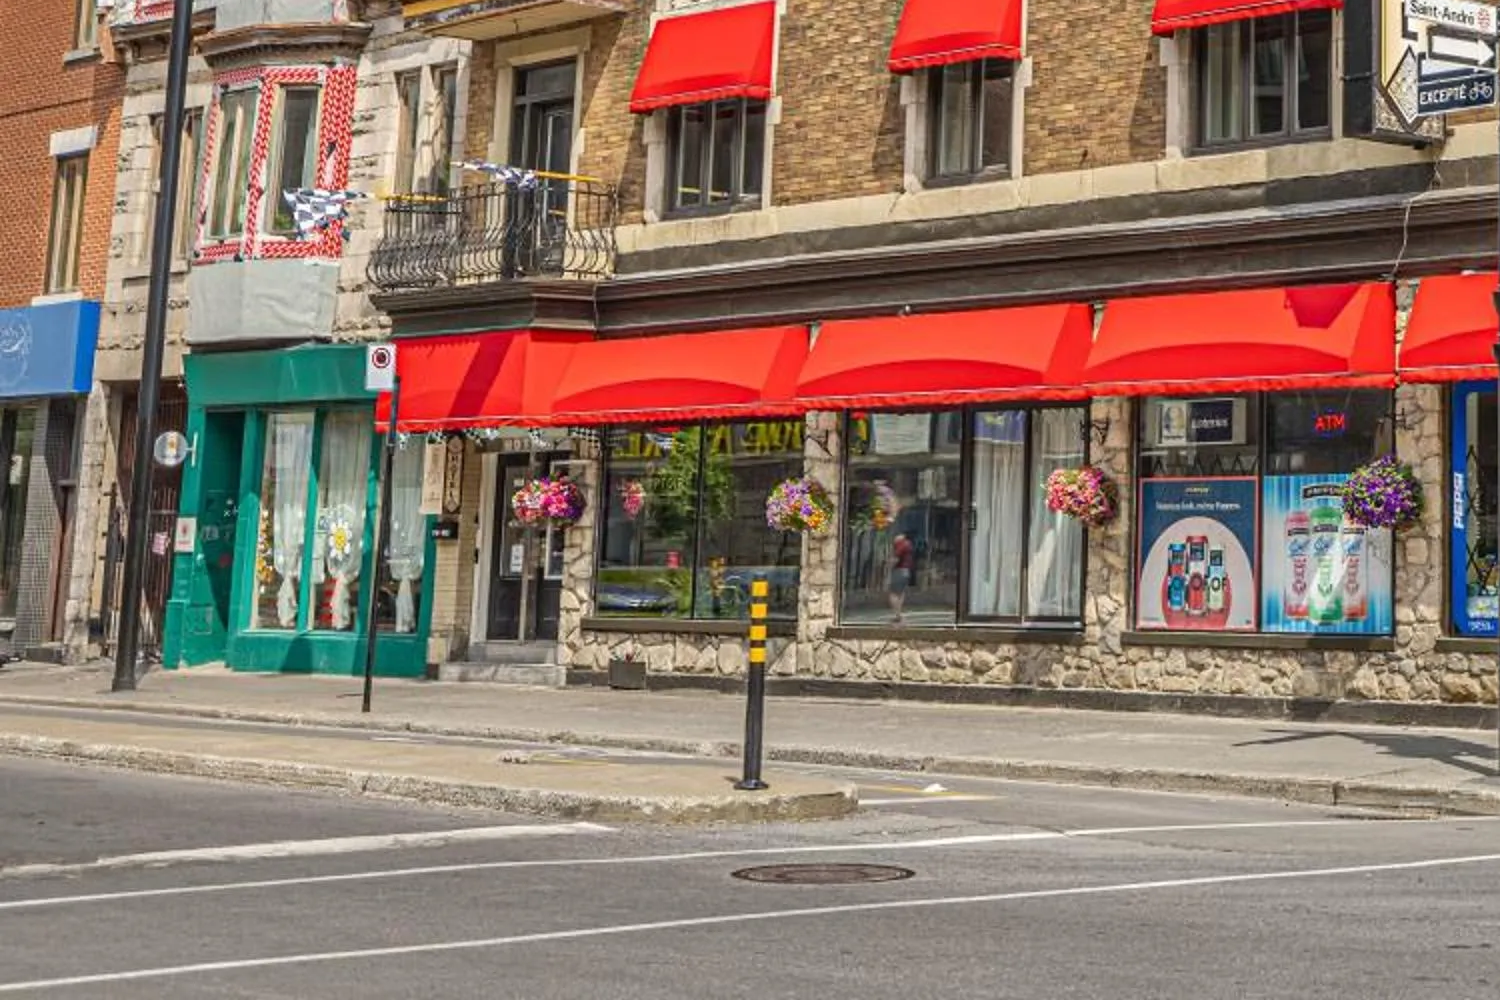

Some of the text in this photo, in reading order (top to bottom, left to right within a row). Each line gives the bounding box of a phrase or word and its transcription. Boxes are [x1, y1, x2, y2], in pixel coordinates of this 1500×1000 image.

[1409, 1, 1475, 26] Saint-André
[1420, 85, 1467, 105] EXCEPTÉ
[1314, 413, 1345, 431] ATM
[1453, 471, 1465, 529] PEPSI
